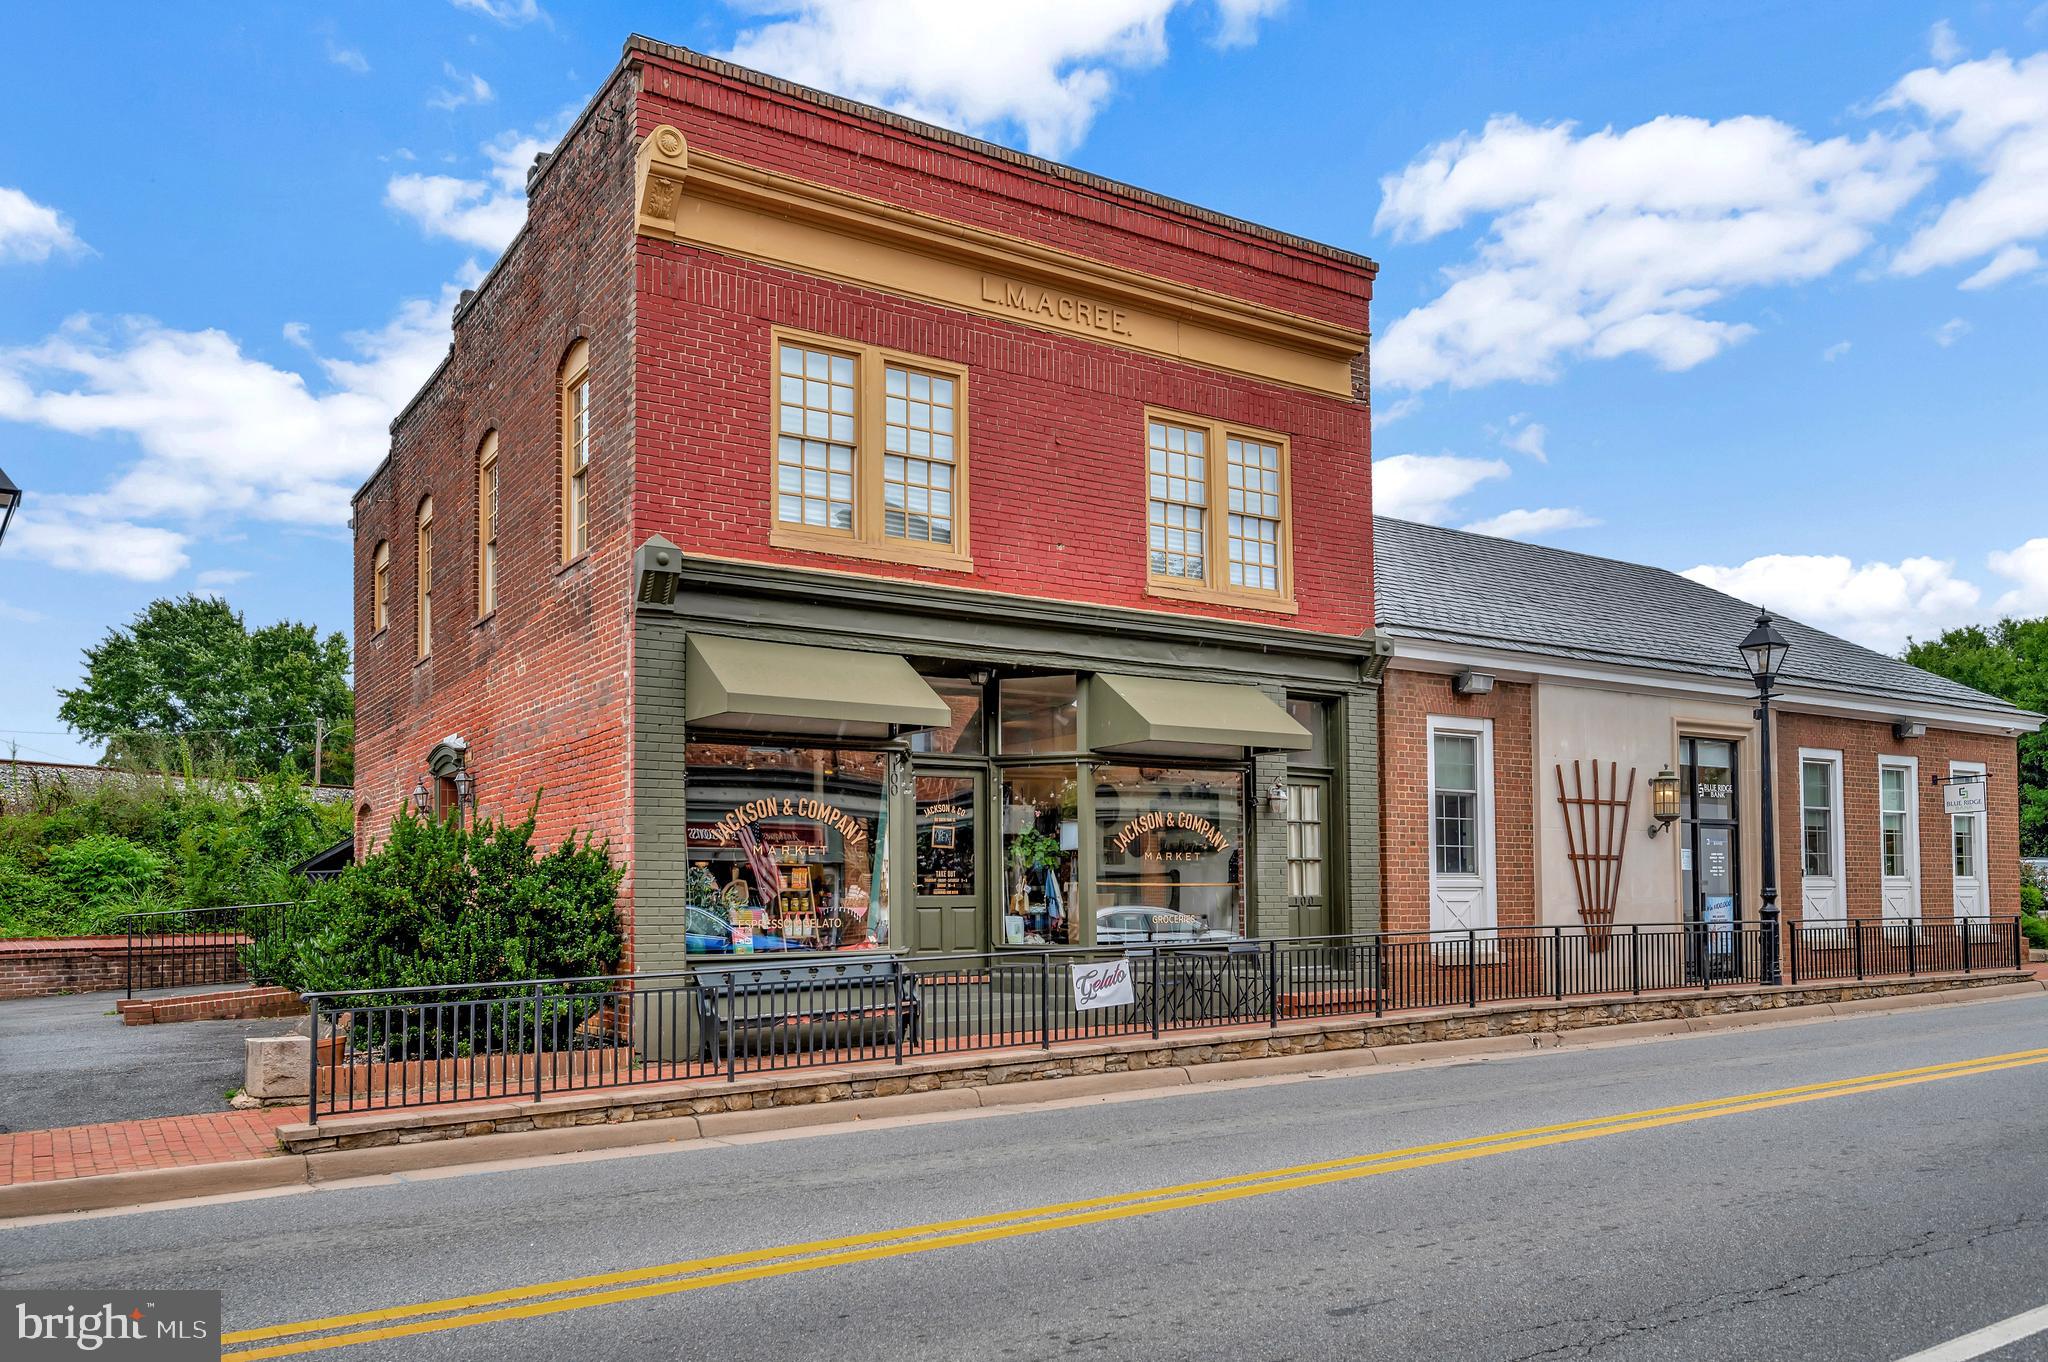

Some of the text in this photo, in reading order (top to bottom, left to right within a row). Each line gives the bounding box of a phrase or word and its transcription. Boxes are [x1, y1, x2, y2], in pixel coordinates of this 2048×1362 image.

[1703, 783, 1733, 793] BLUE RIDGE
[1710, 791, 1726, 799] BANK
[923, 803, 950, 818] JACKSON
[951, 805, 956, 814] &
[711, 796, 868, 847] JACKSON & COMPANY
[1113, 810, 1231, 854] JACKSON & COMPANY
[753, 845, 829, 857] MARKET
[1144, 852, 1201, 861] MARKET
[935, 870, 956, 878] TAKE OUT
[1294, 896, 1314, 907] 100
[738, 918, 793, 930] ESPRESSO
[803, 918, 842, 928] GELATO
[1152, 914, 1196, 924] GROCERIES
[1075, 963, 1128, 1005] Gelato
